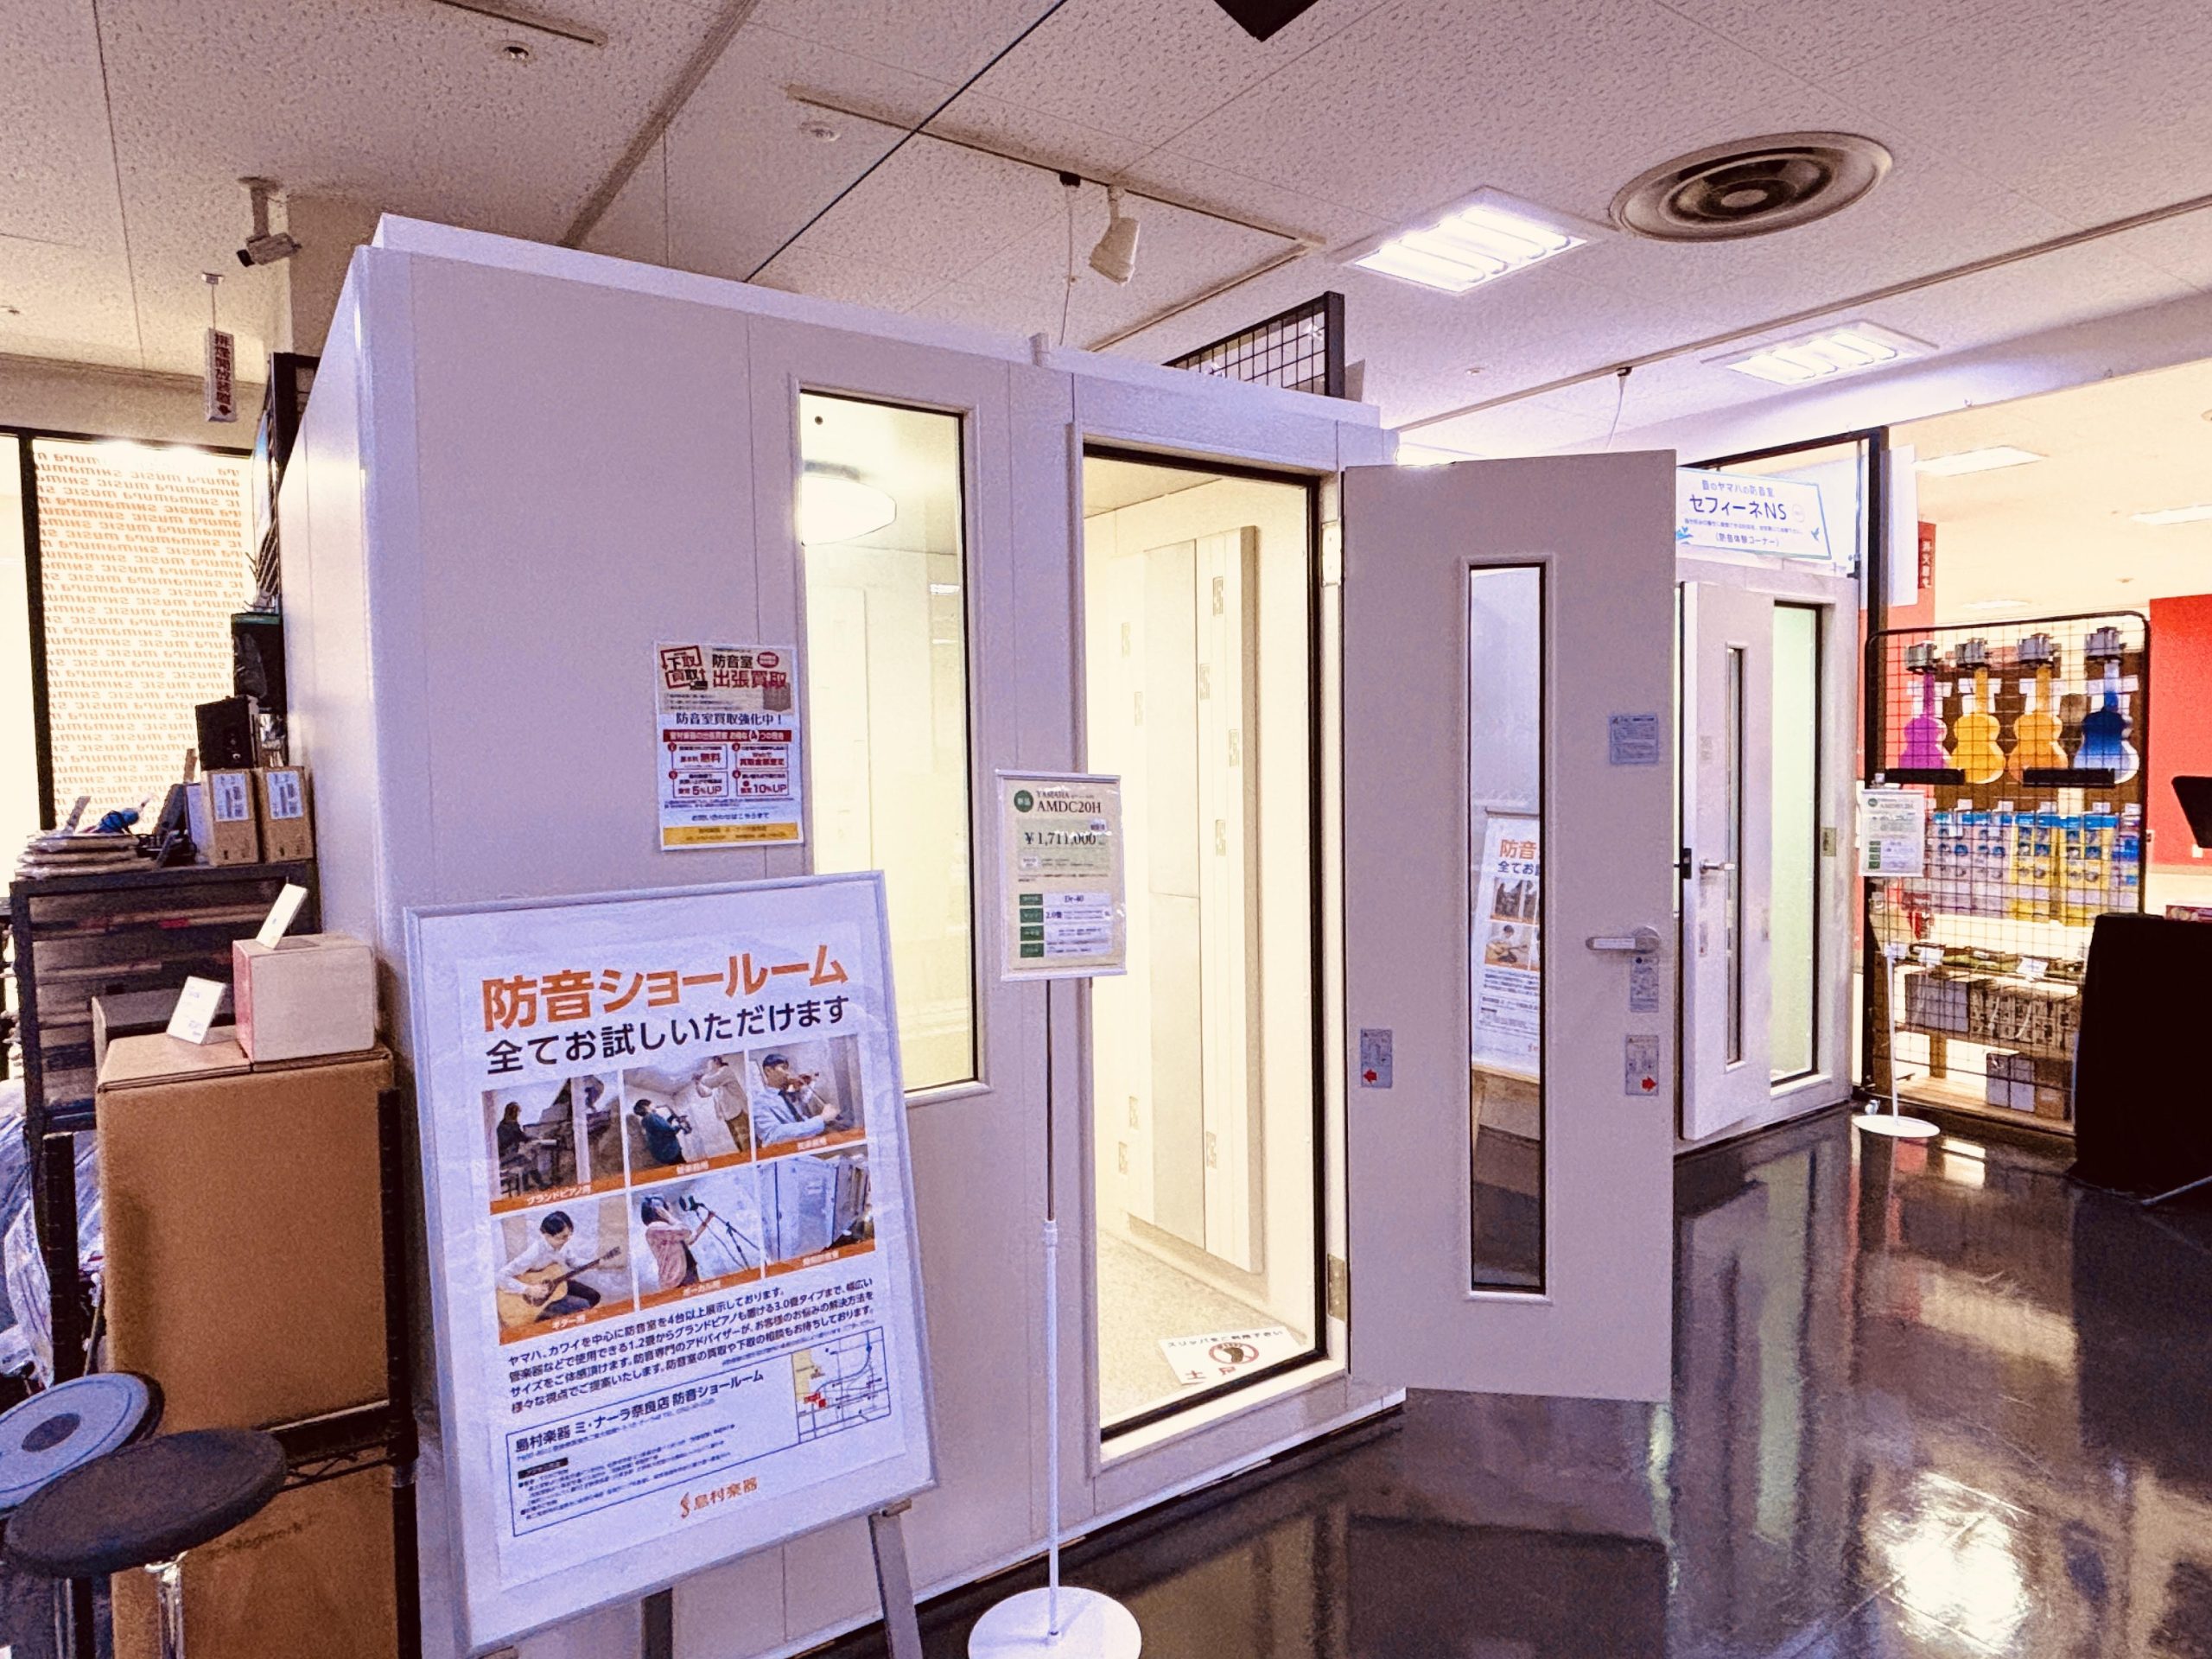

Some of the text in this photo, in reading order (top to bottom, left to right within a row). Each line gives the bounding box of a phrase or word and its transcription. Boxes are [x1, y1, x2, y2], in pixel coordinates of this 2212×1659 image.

[215, 332, 231, 405] 排煙開放装置
[1689, 494, 1787, 520] セフィーネNS
[713, 654, 754, 669] 防音室
[713, 670, 787, 689] 出張買取
[753, 784, 787, 793] 10%UP
[1037, 800, 1102, 813] AMDC20H
[481, 944, 849, 1032] 防音ショールーム
[486, 995, 850, 1075] 全てお試しいただけます
[516, 1425, 571, 1452] 島村楽器
[575, 1396, 670, 1434] ミ・ナーラ奈良店
[672, 1370, 764, 1408] 防音ショールーム
[694, 1477, 758, 1511] 島村楽器
